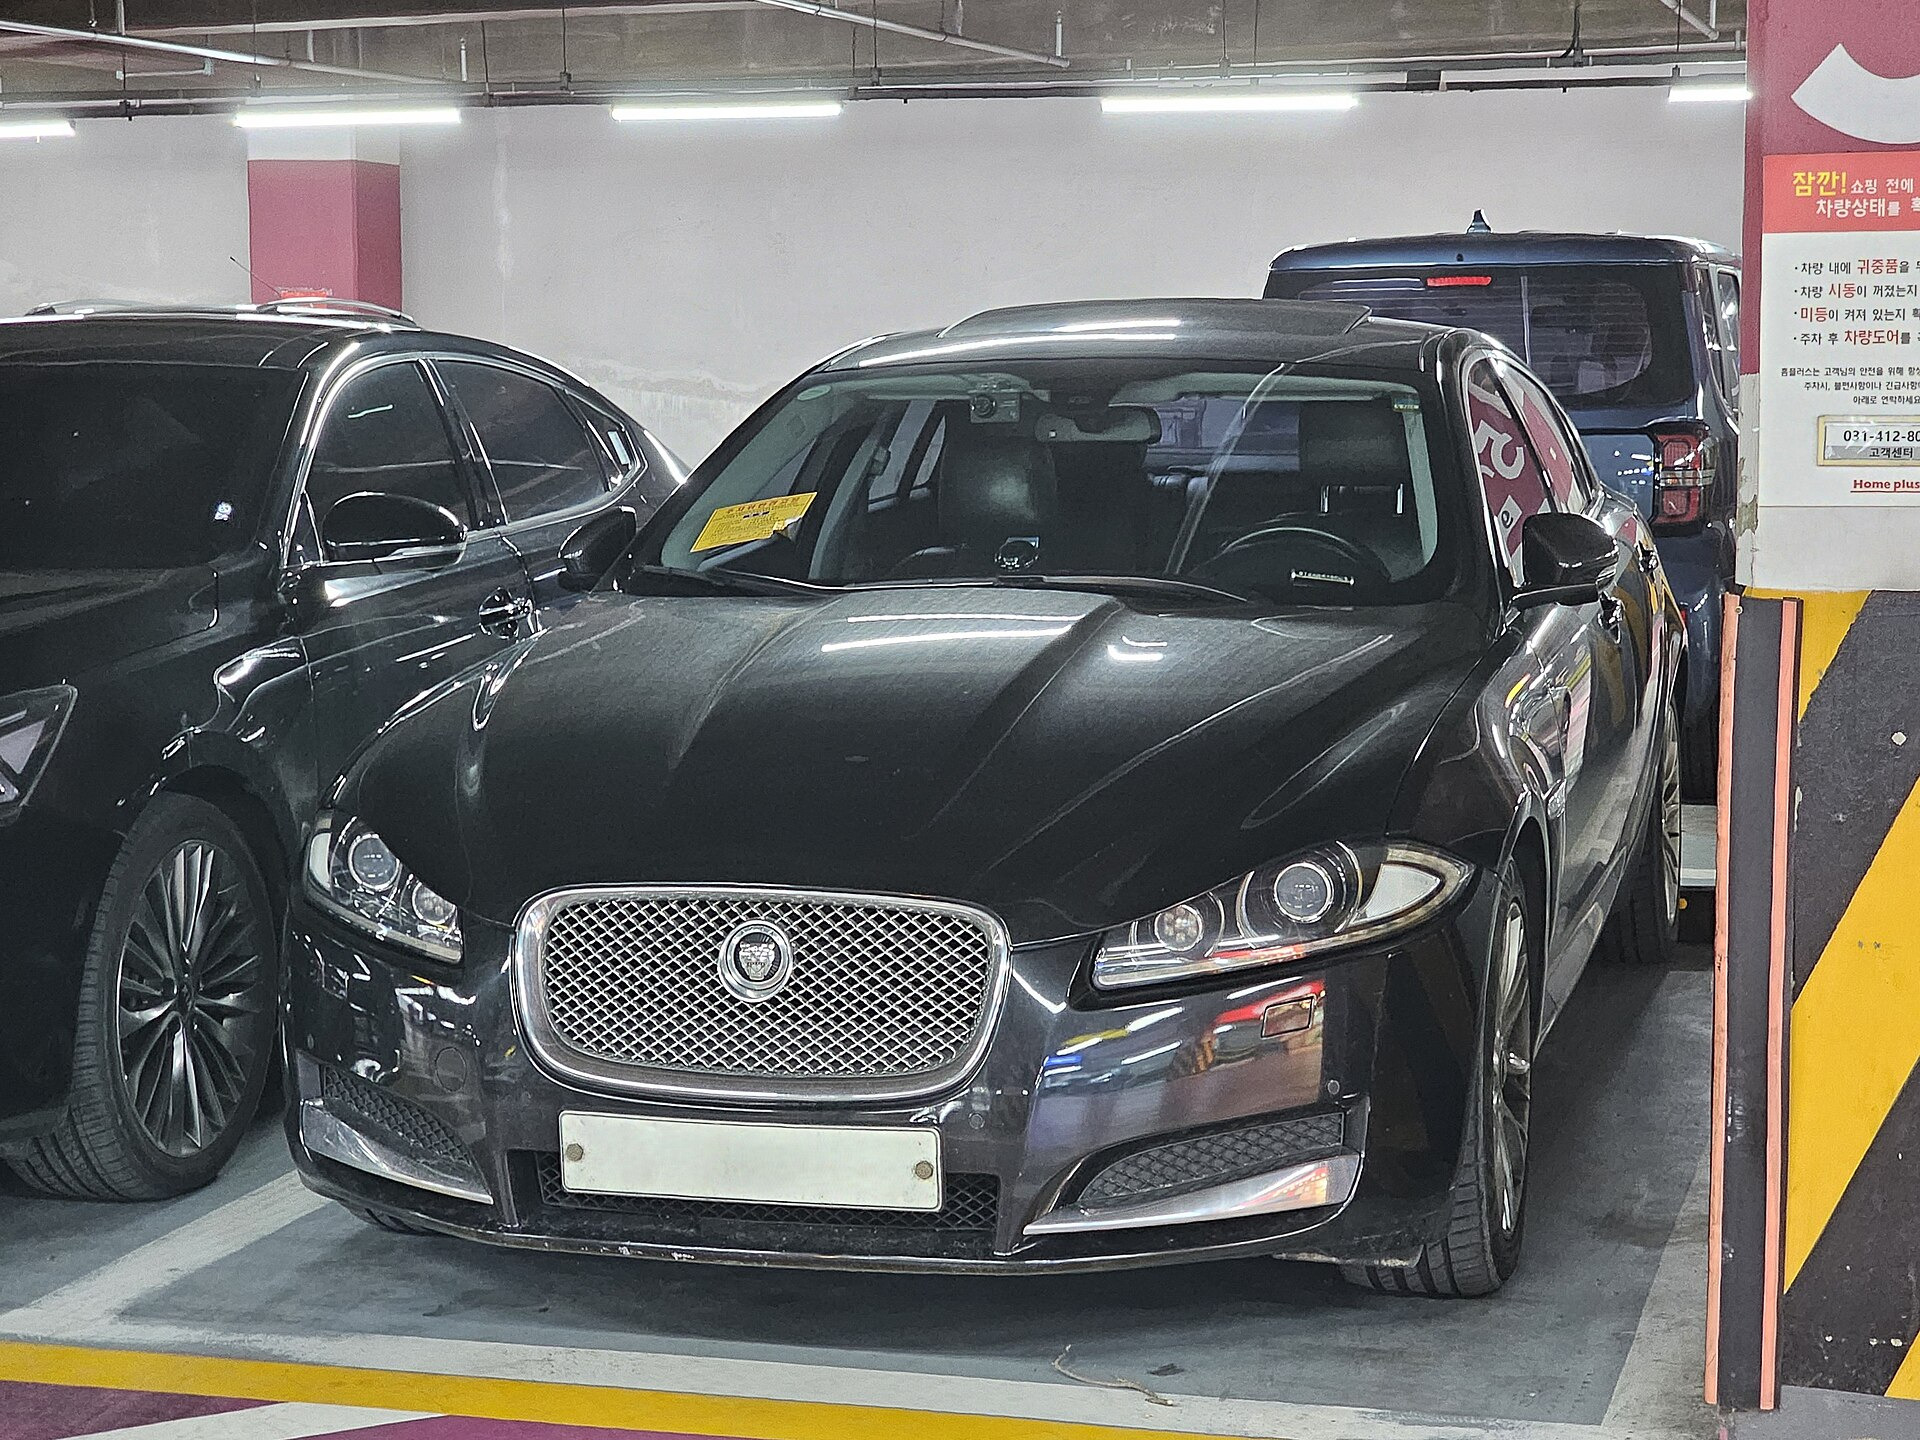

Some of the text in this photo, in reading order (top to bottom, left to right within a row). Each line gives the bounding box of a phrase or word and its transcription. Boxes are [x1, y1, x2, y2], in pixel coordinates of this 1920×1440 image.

[1792, 171, 1914, 197] 잠깐! 쇼핑 전에
[1816, 198, 1901, 218] 차량상태를
[1800, 262, 1823, 275] 차량
[1828, 262, 1851, 275] 내에
[1857, 258, 1910, 275] 귀중품을
[1800, 283, 1917, 299] 차량 시동이 꺼졌는지
[1800, 307, 1839, 322] 미등이
[1844, 308, 1867, 322] 켜져
[1872, 308, 1906, 322] 있는지
[1800, 333, 1822, 346] 주차
[1827, 332, 1839, 346] 후
[1844, 329, 1911, 346] 차량도어를
[1781, 367, 1821, 377] 홈플러스는
[1824, 367, 1856, 377] 고객님의
[1859, 366, 1884, 377] 안전을
[1887, 366, 1904, 376] 위해
[1853, 395, 1877, 405] 아래로
[1869, 446, 1914, 459] 고객센터
[1853, 479, 1920, 493] Home plus
